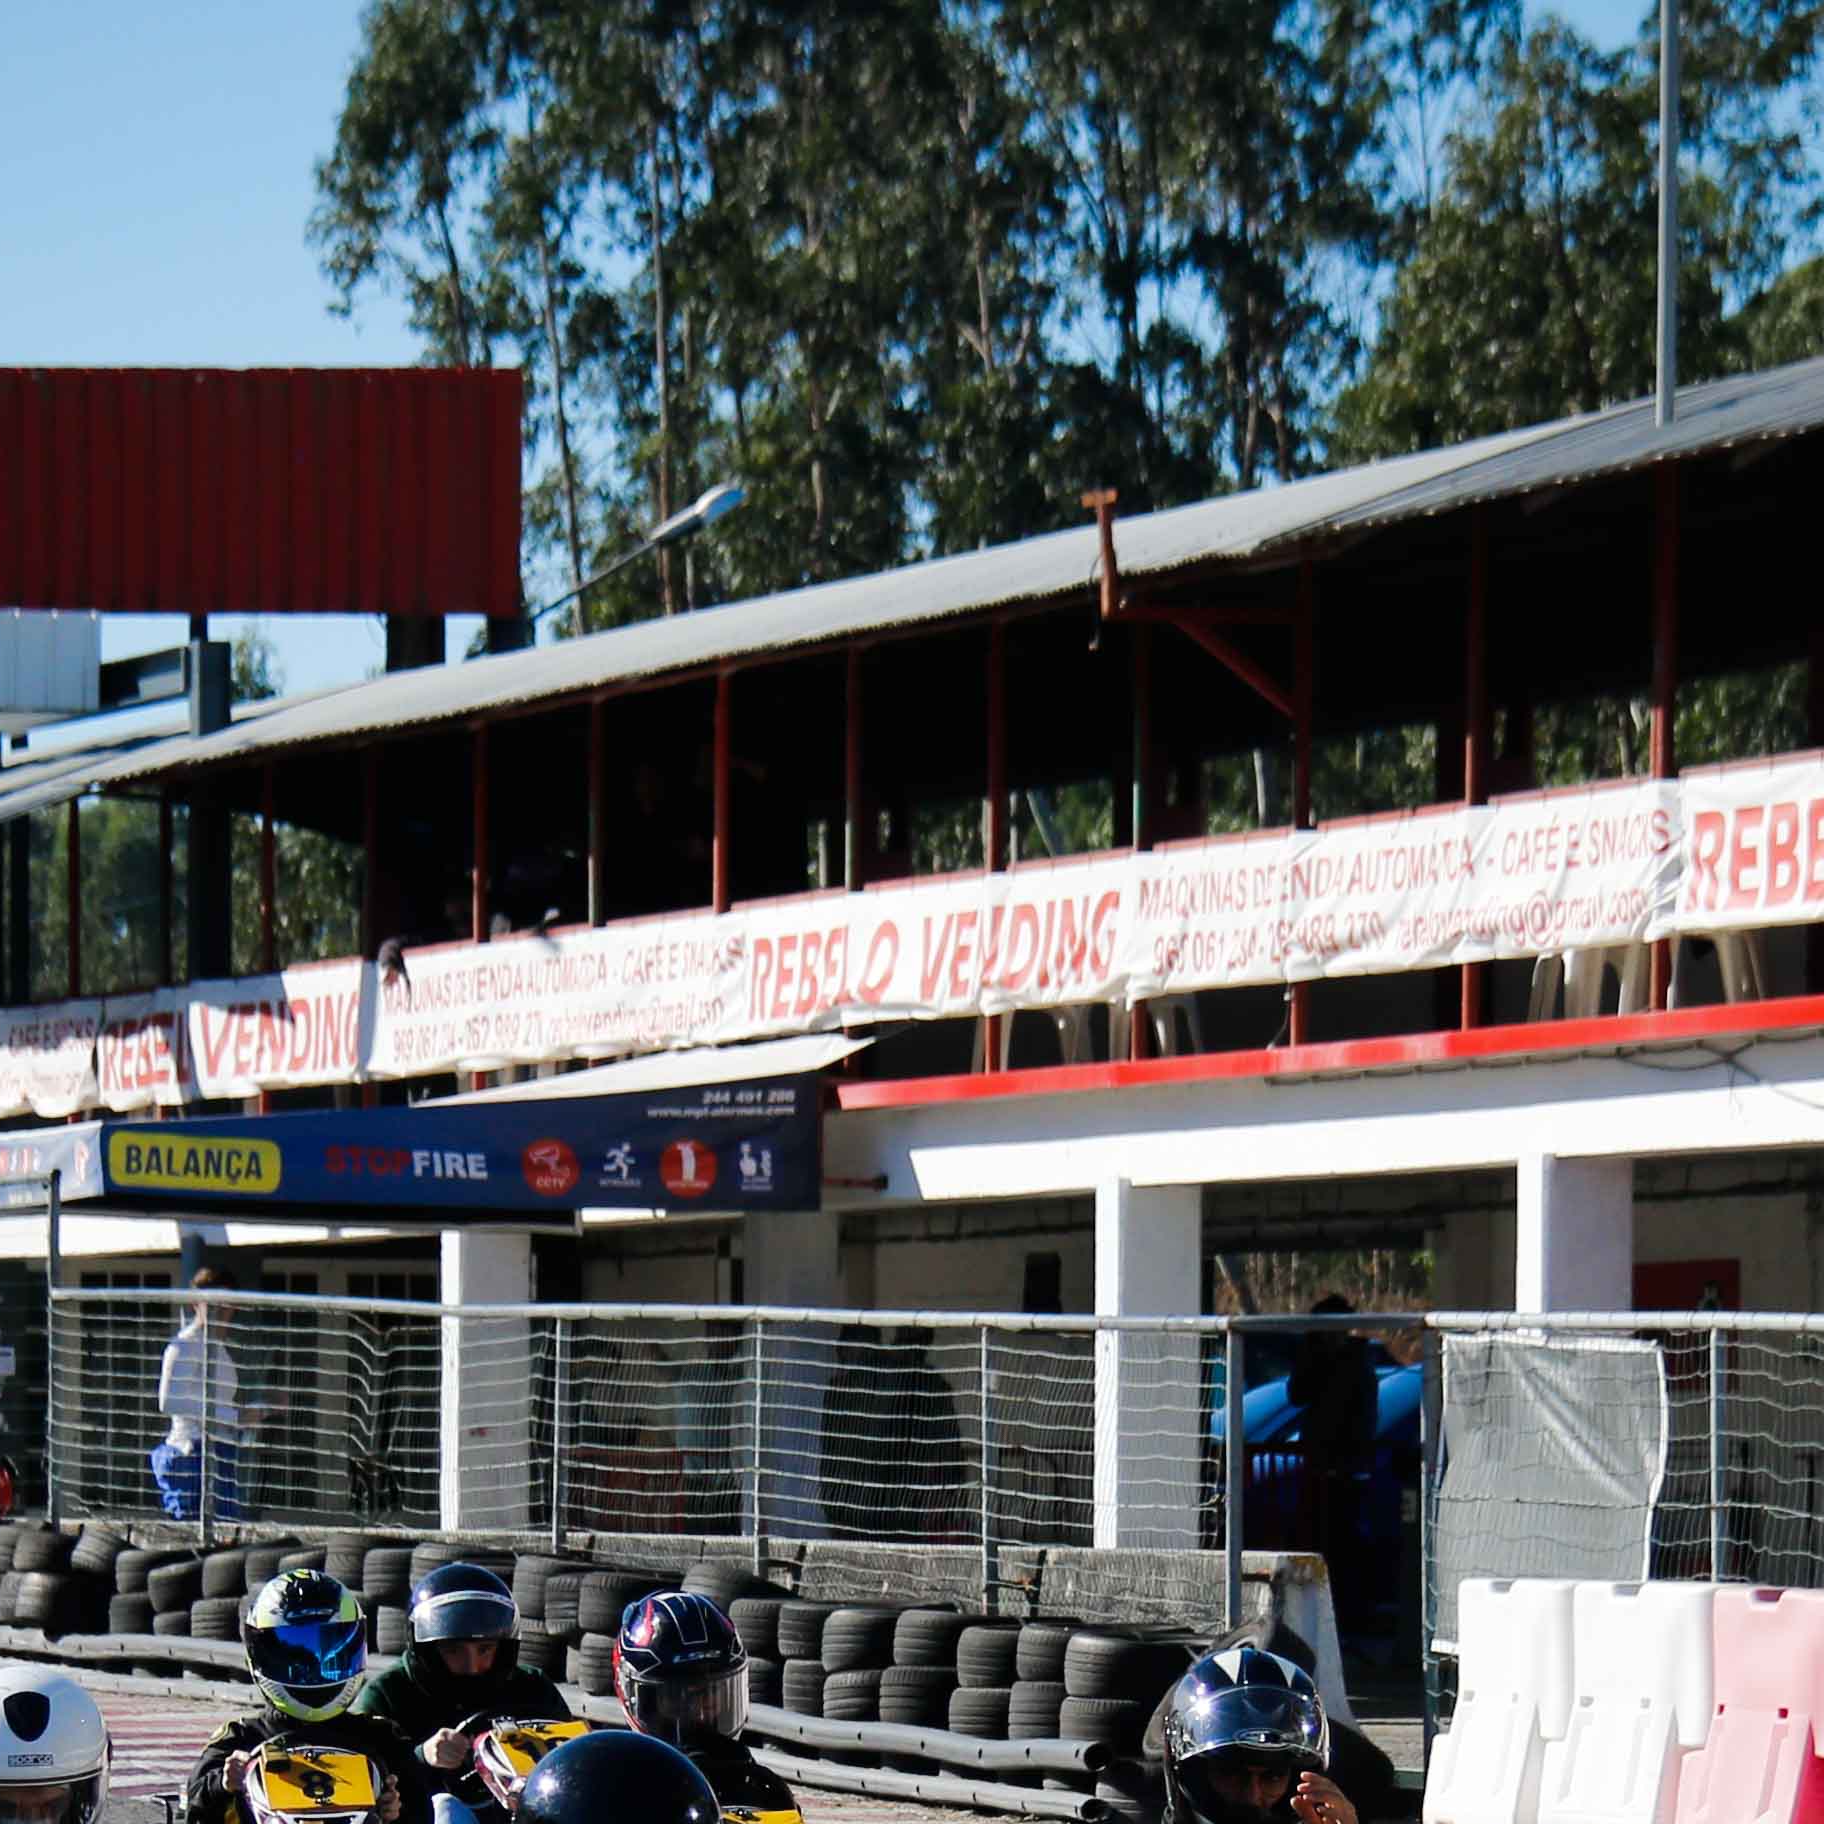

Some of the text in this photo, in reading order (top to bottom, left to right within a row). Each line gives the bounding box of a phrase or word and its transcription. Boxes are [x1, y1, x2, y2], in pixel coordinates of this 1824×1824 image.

[1501, 813, 1557, 876] CAFÉ
[1589, 809, 1671, 866] SNACKS
[749, 890, 1120, 1023] REBELO VENDING
[125, 1144, 263, 1184] BALANÇA
[300, 1770, 336, 1799] 8
